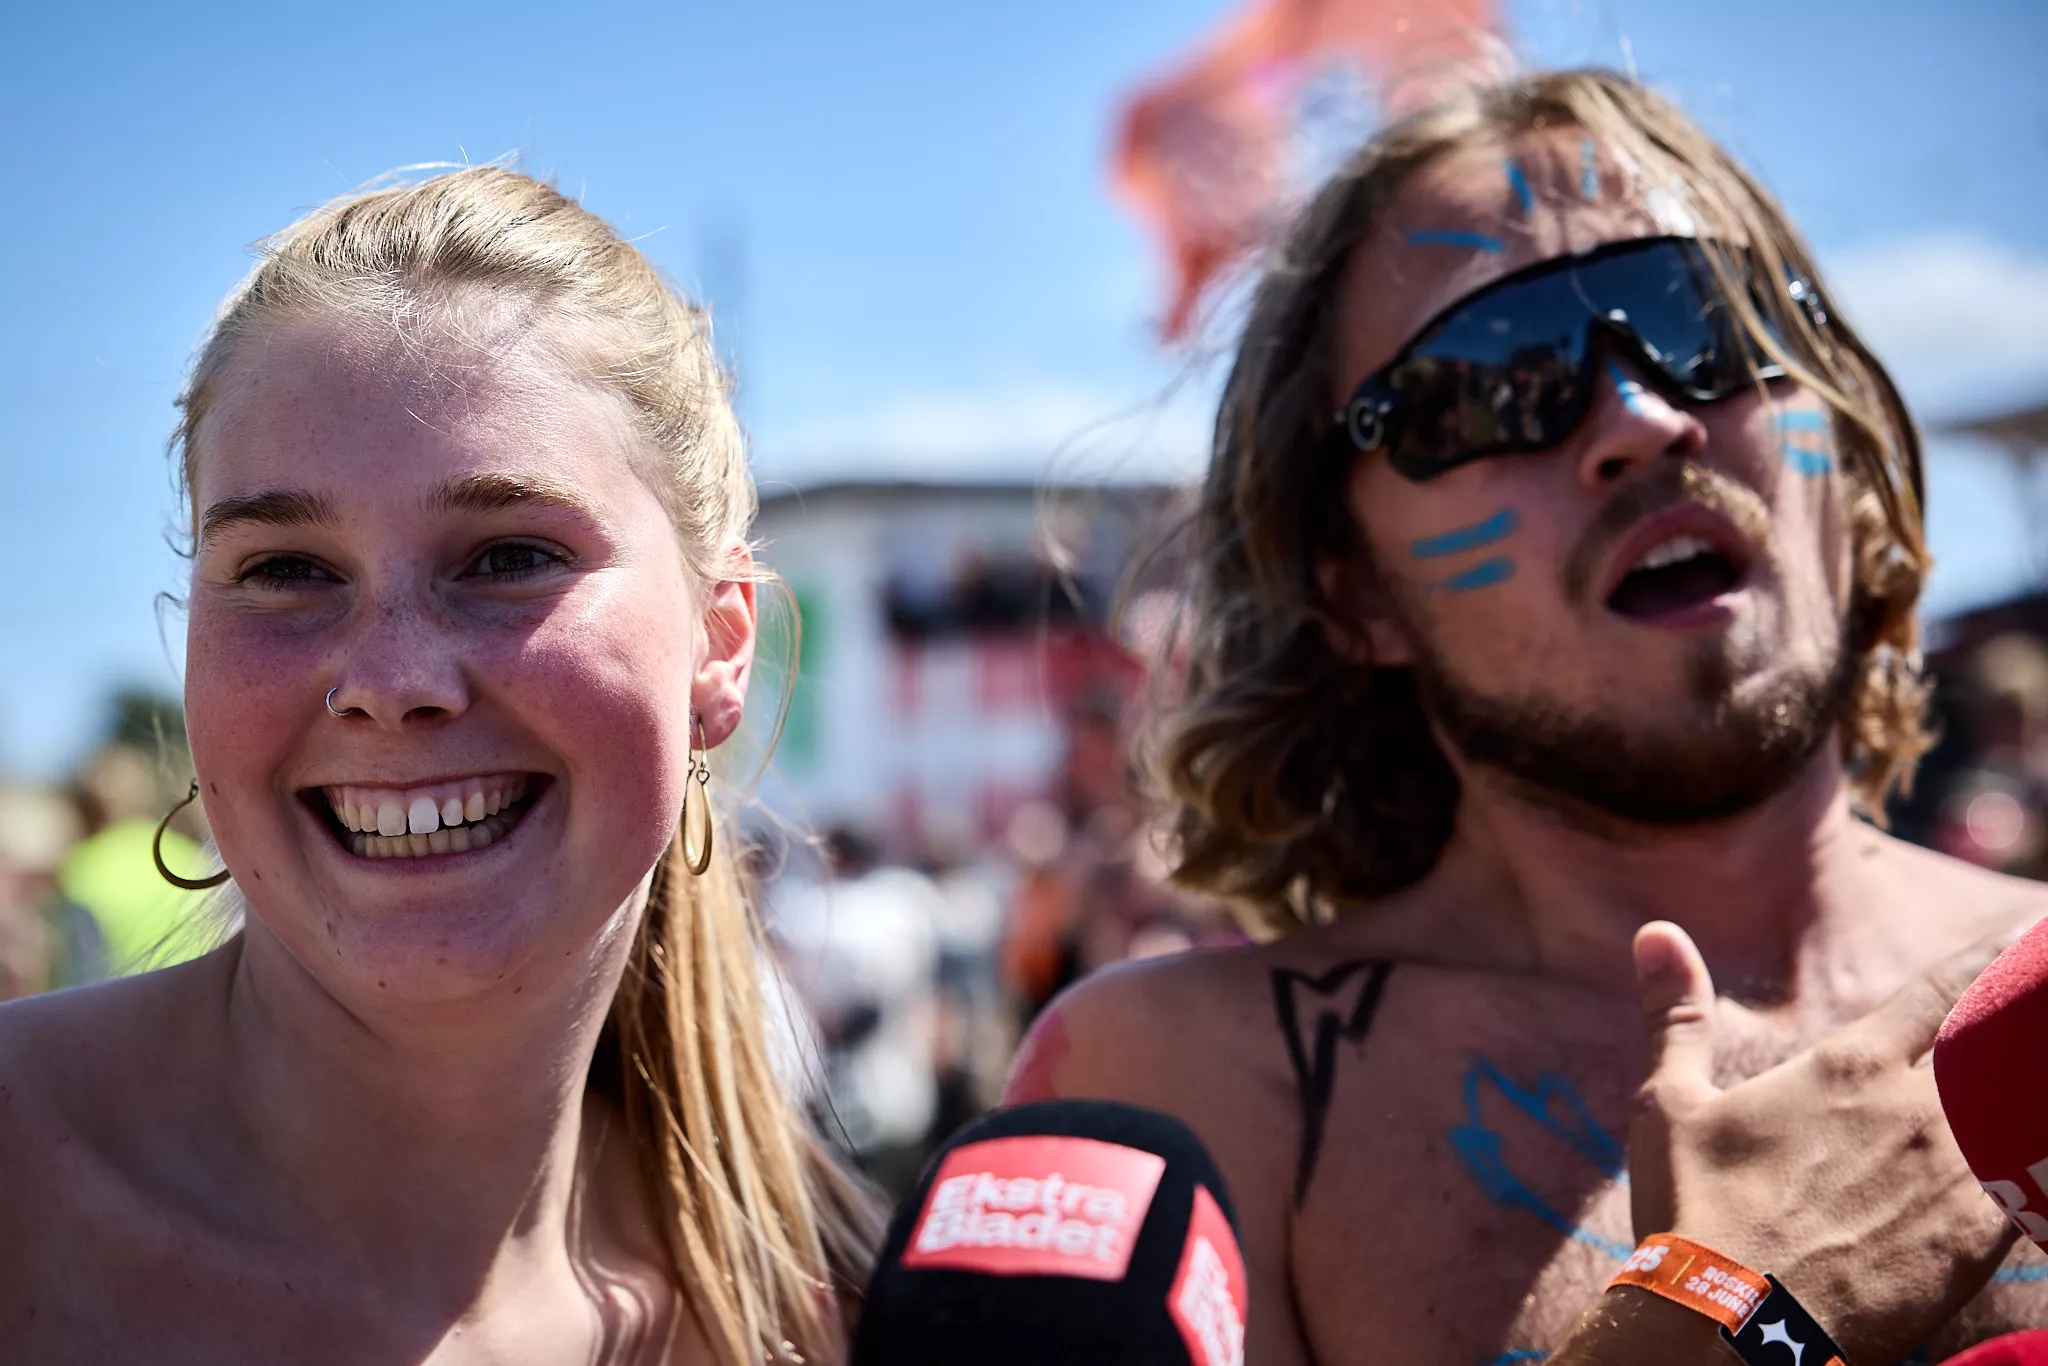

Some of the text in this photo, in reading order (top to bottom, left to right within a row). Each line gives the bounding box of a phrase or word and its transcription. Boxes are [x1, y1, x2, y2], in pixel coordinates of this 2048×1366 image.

[931, 1172, 1127, 1223] Ekstra
[916, 1205, 1120, 1263] Bladet
[1624, 1244, 1670, 1272] 25
[1684, 1275, 1750, 1318] 28 JUNE
